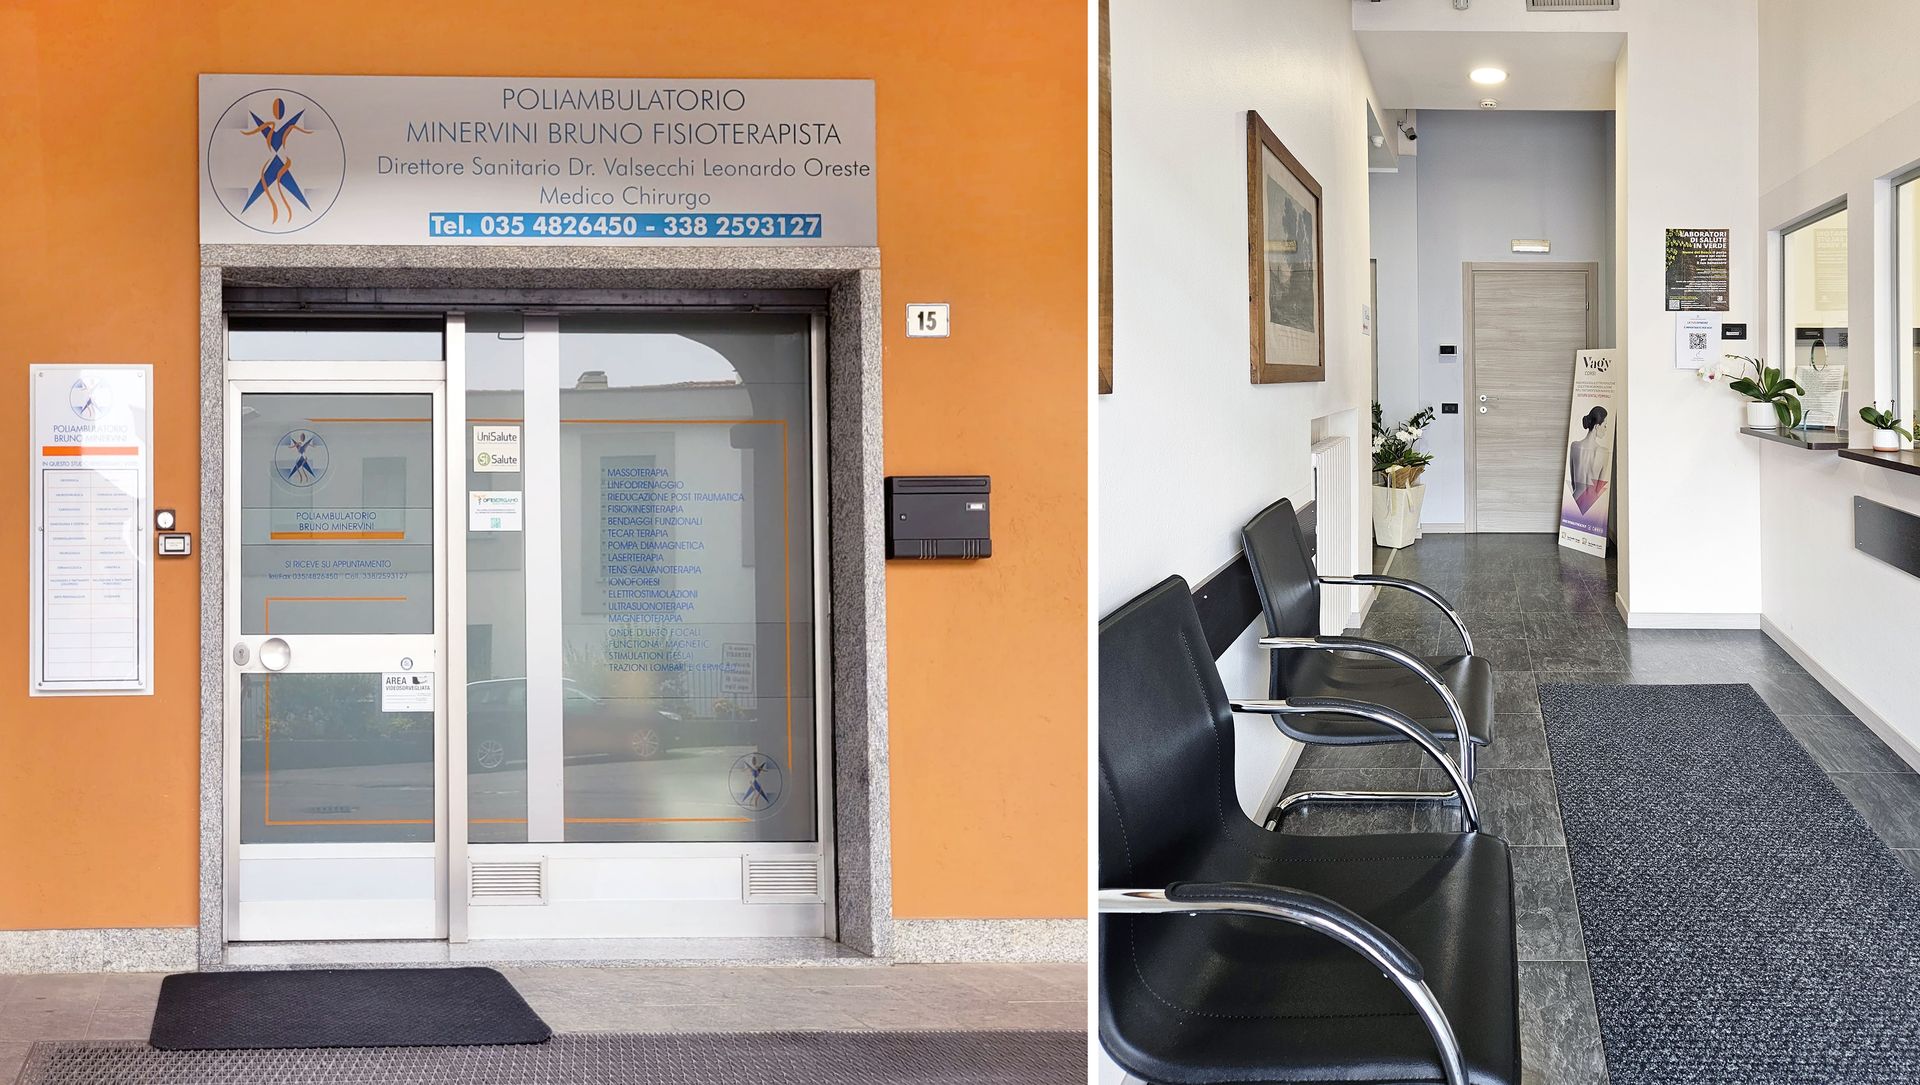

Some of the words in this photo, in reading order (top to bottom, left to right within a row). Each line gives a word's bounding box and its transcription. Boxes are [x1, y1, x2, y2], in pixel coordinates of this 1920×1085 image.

[503, 88, 745, 111] POLIAMBULATORIO
[407, 121, 537, 144] MINERVINI
[548, 122, 642, 145] BRUNO
[653, 122, 842, 145] FISIOTERAPISTA
[377, 155, 464, 175] Direttore
[472, 156, 560, 176] Sanitario
[568, 157, 595, 176] Dr.
[603, 157, 694, 177] Valsecchi
[703, 157, 796, 177] Leonardo
[804, 158, 870, 177] Oreste
[539, 185, 614, 205] Medico
[622, 186, 711, 210] Chirurgo
[431, 215, 472, 235] Tel.
[480, 216, 525, 235] 035
[532, 216, 637, 236] 4826450
[663, 217, 708, 236] 338
[716, 217, 820, 236] 2593127
[917, 310, 937, 331] 15
[1583, 356, 1612, 372] Vagy
[54, 434, 82, 443] BRUNO
[477, 431, 518, 442] UniSalute
[491, 454, 518, 465] Salute
[607, 469, 669, 477] MASSOTERAPIA
[607, 481, 684, 489] LINFODRENAGGIO
[607, 493, 668, 501] RIEDUCAZIONE
[671, 493, 691, 501] POST
[694, 493, 745, 502] TRAUMATICA
[607, 505, 684, 513] FISIOKINESITERAPIA
[296, 512, 377, 521] POLIAMBULATORIO
[607, 517, 653, 525] BENDAGGI
[655, 517, 703, 525] FUNZIONALI
[299, 523, 330, 531] BRUNO
[331, 522, 375, 531] MINERVINI
[608, 529, 634, 537] TECAR
[637, 529, 668, 537] TERAPIA
[608, 541, 638, 550] POMPA
[640, 541, 704, 550] DIAMAGNETICA
[608, 553, 664, 562] LASERTERAPIA
[293, 560, 319, 569] RICEVE
[321, 560, 331, 569] SU
[332, 560, 392, 569] APPUNTAMENTO
[608, 565, 628, 574] TENS
[629, 565, 701, 574] GALVANOTERAPIA
[608, 577, 660, 586] IONOFORESI
[608, 589, 698, 598] ELETTROSTIMOLAZIONI
[608, 602, 694, 610] ULTRASUONOTERAPIA
[608, 614, 683, 623] MAGNETOTERAPIA
[608, 652, 664, 660] STIMULATION
[609, 663, 648, 672] TRAZIONI
[386, 676, 407, 685] AREA
